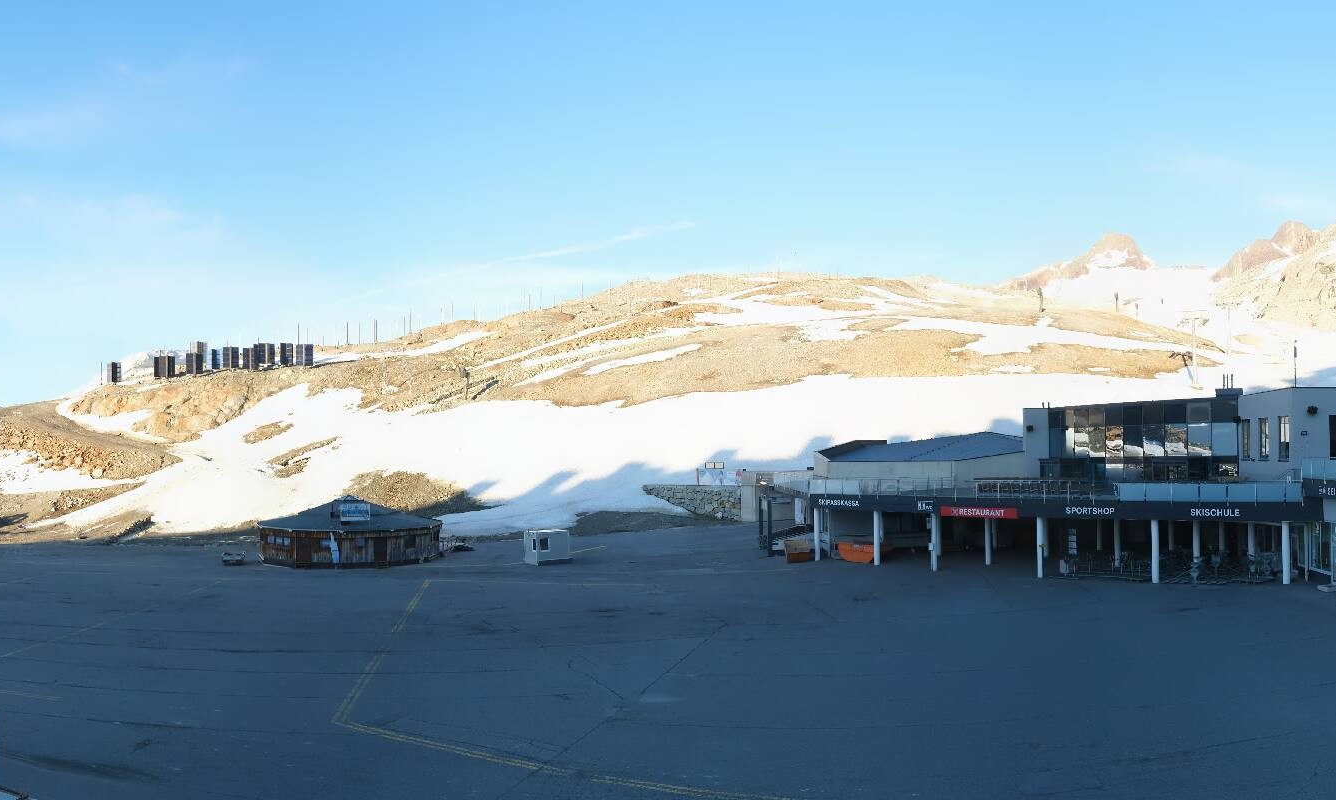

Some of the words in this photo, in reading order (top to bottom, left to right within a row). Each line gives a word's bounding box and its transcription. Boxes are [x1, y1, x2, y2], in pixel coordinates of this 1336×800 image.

[959, 508, 1005, 517] RESTAURANT
[1065, 506, 1115, 515] SPORTSHOP
[1190, 508, 1240, 517] SKISCHULE
